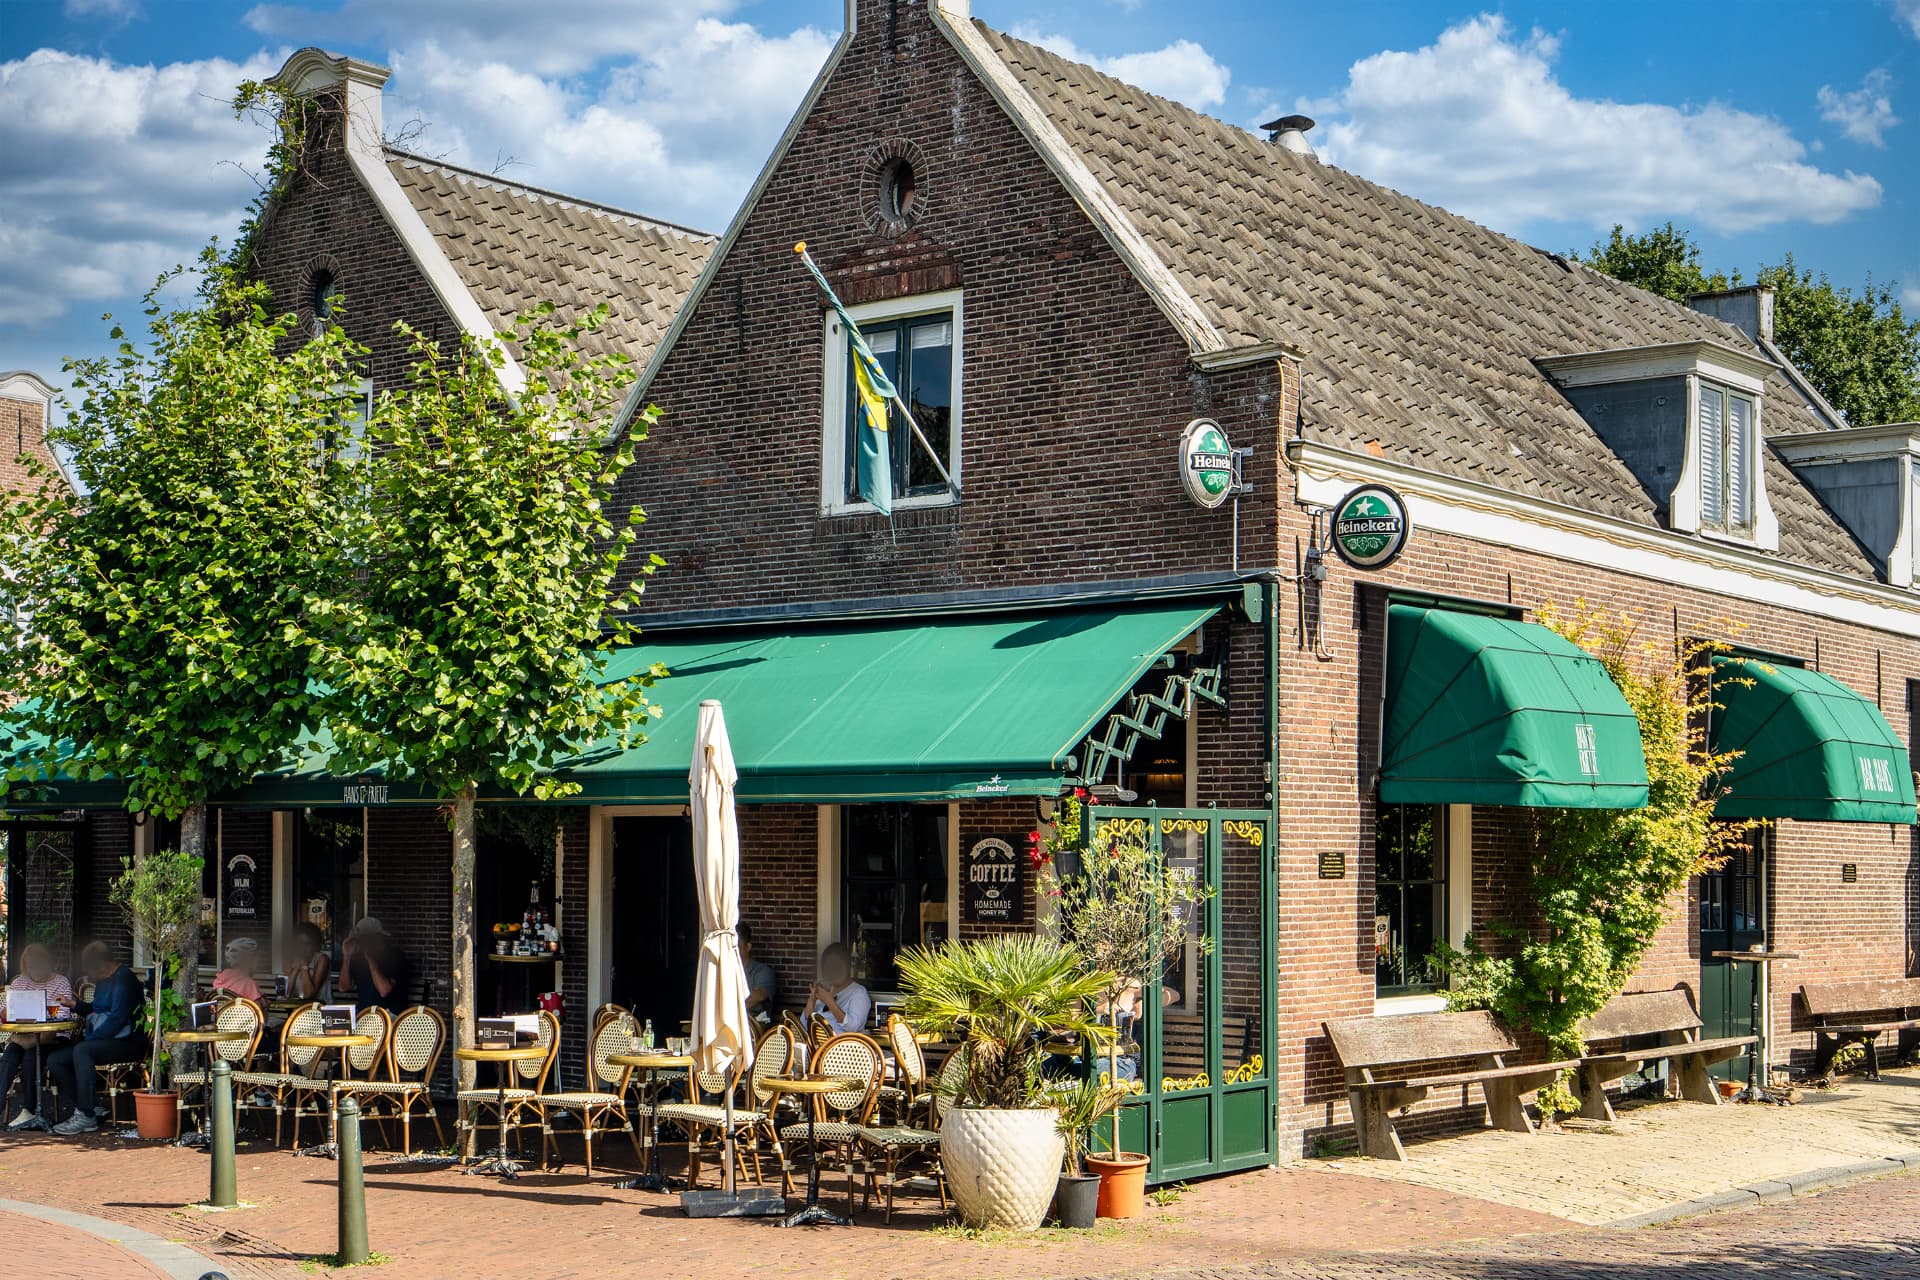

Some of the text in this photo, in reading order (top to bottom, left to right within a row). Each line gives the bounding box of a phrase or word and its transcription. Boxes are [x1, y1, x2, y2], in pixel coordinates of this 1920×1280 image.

[1338, 519, 1396, 534] Heineken
[344, 785, 359, 804] HANS
[976, 784, 1009, 792] Heineken
[970, 864, 1016, 882] COFFEE
[974, 900, 1012, 909] HOMEMADE
